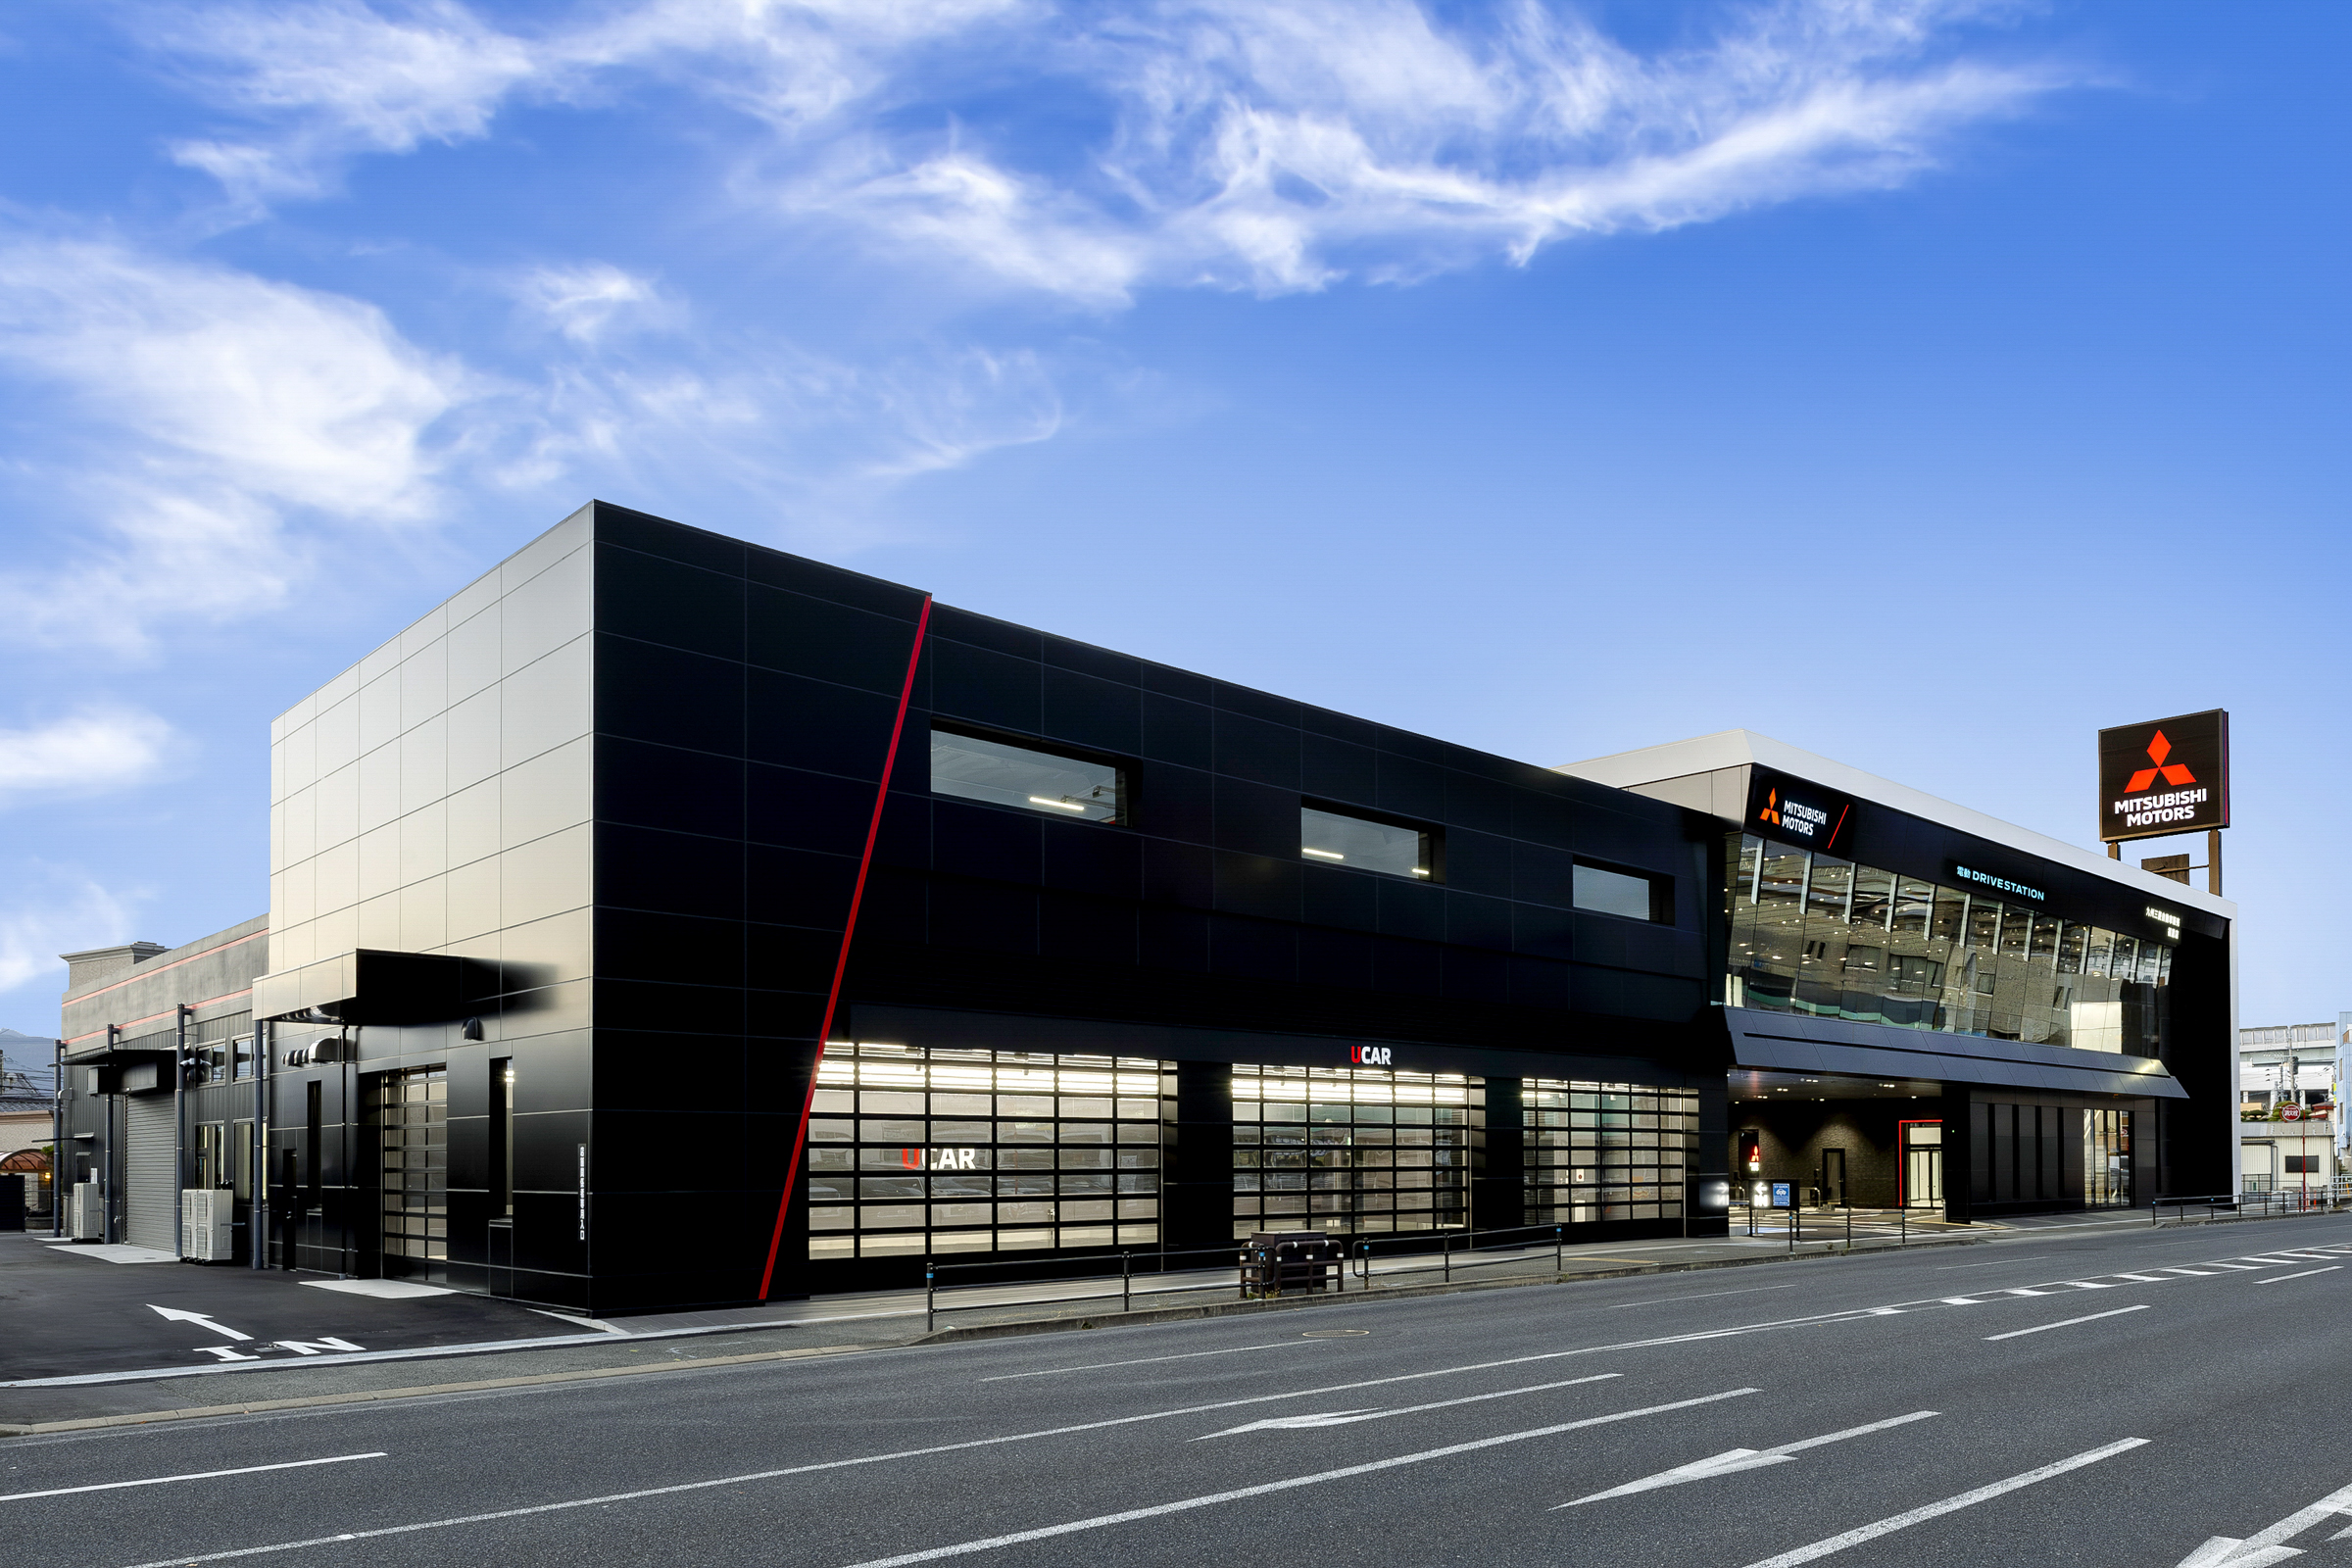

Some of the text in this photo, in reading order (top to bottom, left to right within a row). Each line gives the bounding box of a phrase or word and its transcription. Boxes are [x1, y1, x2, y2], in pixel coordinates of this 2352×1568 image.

[2114, 788, 2207, 814] MITSUBISHI
[1784, 800, 1827, 825] MITSUBISHI
[2127, 806, 2194, 827] MOTORS
[1782, 814, 1814, 836] MOTORS
[1350, 1046, 1392, 1065] UCAR
[902, 1148, 976, 1170] UCAR
[192, 1337, 368, 1362] IN
